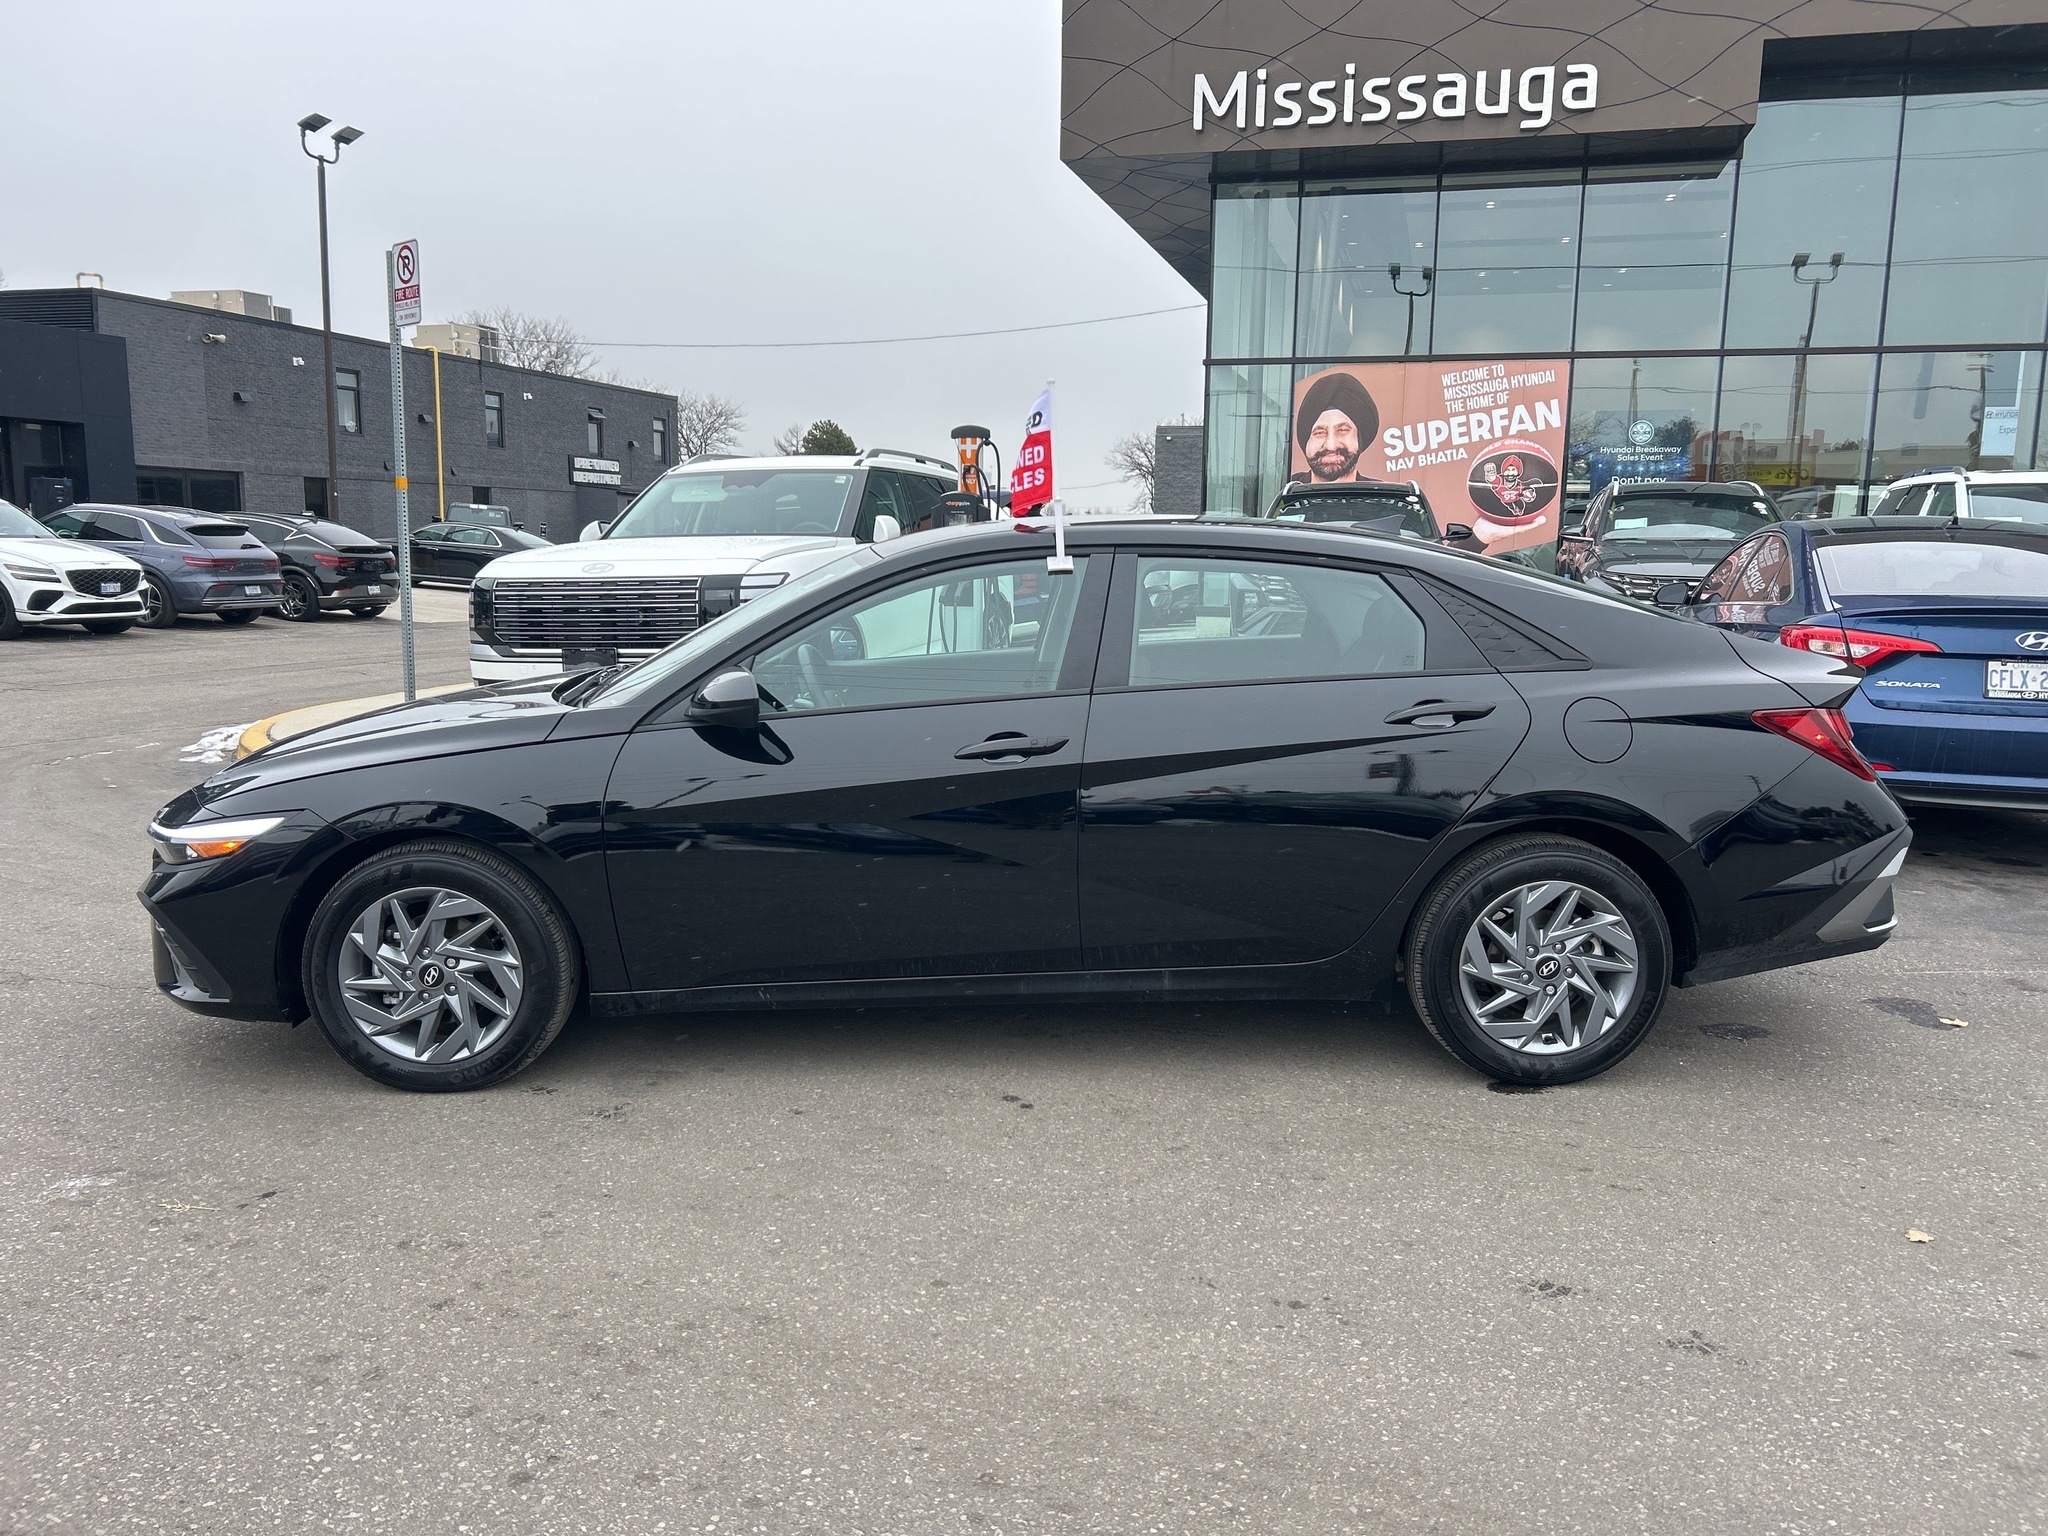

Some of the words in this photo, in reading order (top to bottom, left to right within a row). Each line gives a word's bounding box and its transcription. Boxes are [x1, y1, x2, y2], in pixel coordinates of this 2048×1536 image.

[1193, 63, 1599, 131] Mississauga
[395, 289, 405, 301] FIRE
[405, 286, 419, 299] ROUTE
[1441, 366, 1490, 386] WELCOME
[1491, 364, 1505, 377] TO
[1443, 378, 1509, 400] MISSISSAUGA
[1510, 370, 1555, 389] HYUNDAI
[1445, 400, 1465, 414] THE
[1467, 395, 1497, 411] HOME
[1497, 391, 1510, 405] OF
[1383, 398, 1562, 457] SUPERFAN
[1386, 455, 1415, 473] NAV
[1418, 447, 1468, 467] BHATIA
[1600, 446, 1634, 455] Hyundai
[1635, 446, 1682, 454] Breakaway
[573, 470, 621, 485] DEPARTMENT
[1875, 680, 1941, 689] SONATA
[1611, 990, 1657, 1051] KUMHO
[448, 1041, 521, 1083] KUMHO
